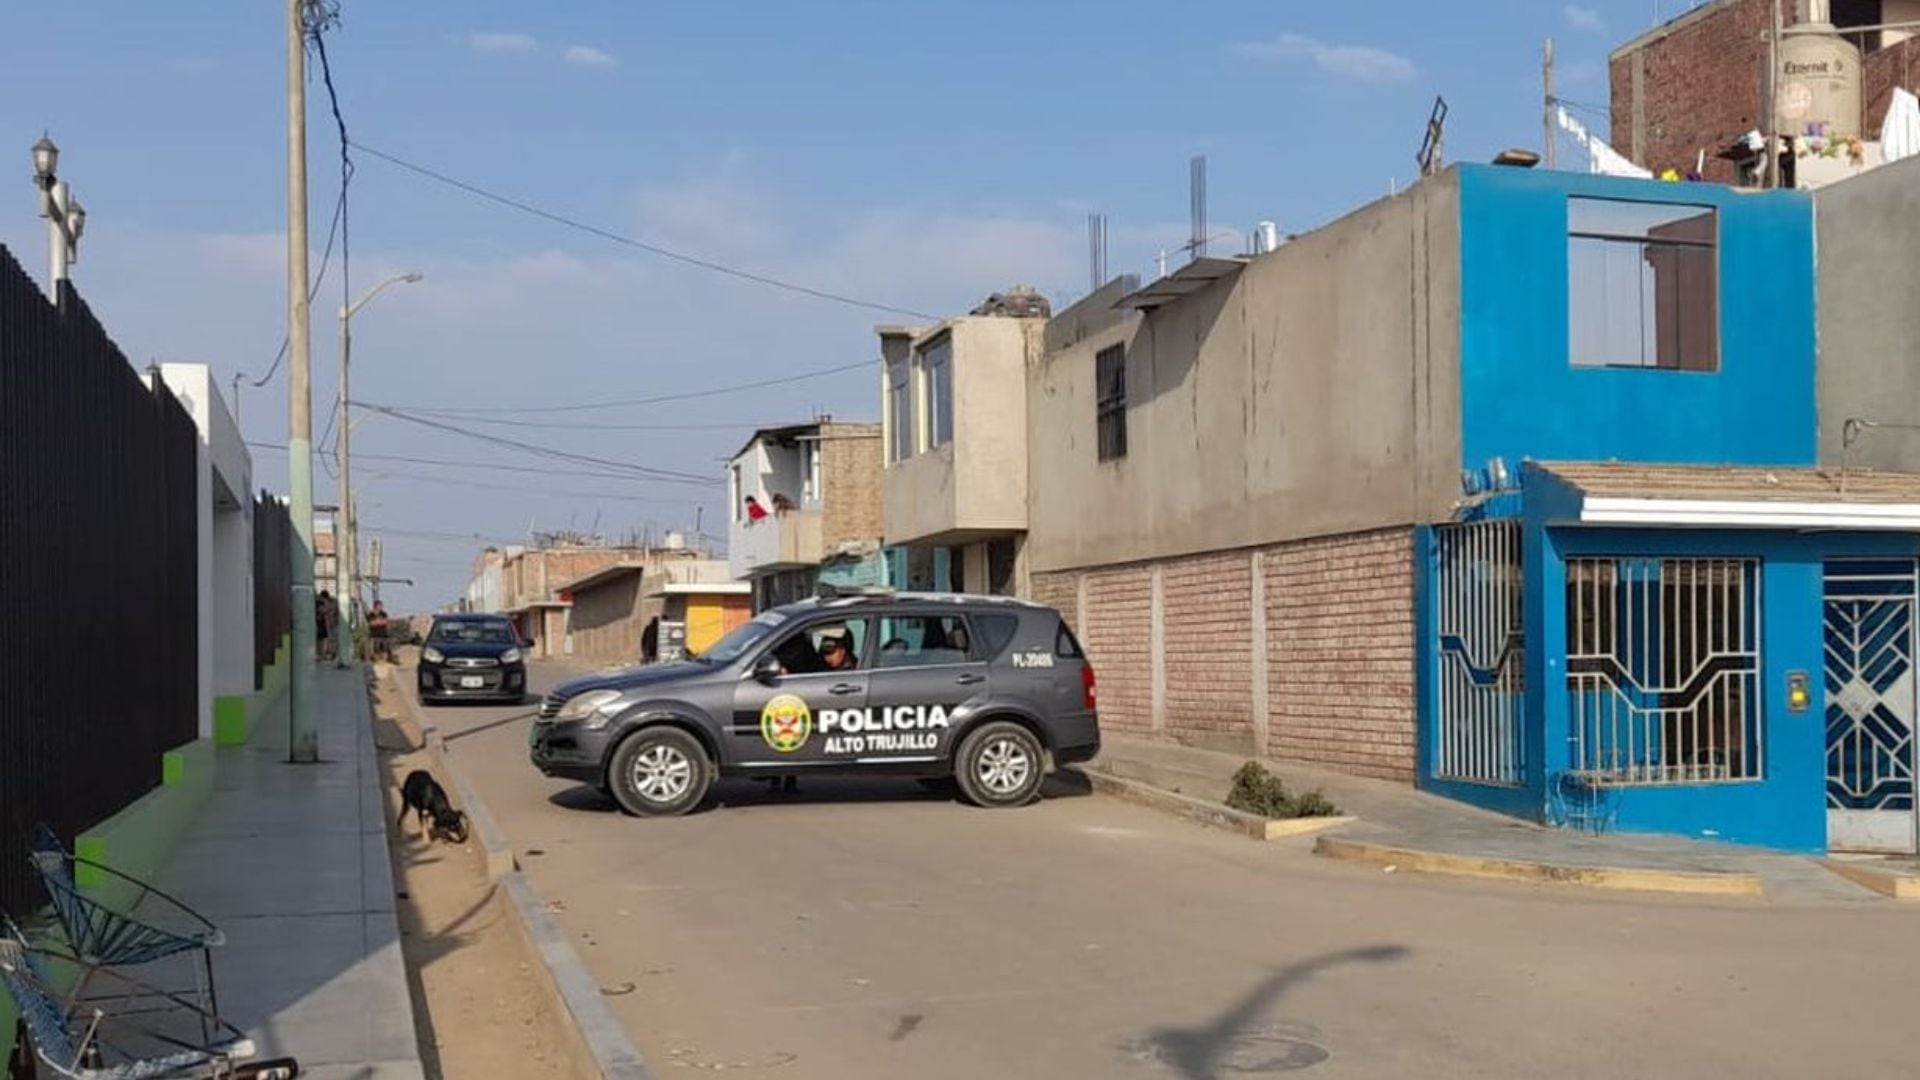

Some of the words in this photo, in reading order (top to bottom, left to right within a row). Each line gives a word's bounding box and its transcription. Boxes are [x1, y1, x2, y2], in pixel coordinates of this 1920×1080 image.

[818, 705, 949, 733] POLICIA
[824, 737, 864, 753] ALTO
[866, 733, 938, 751] TRUJILLO
